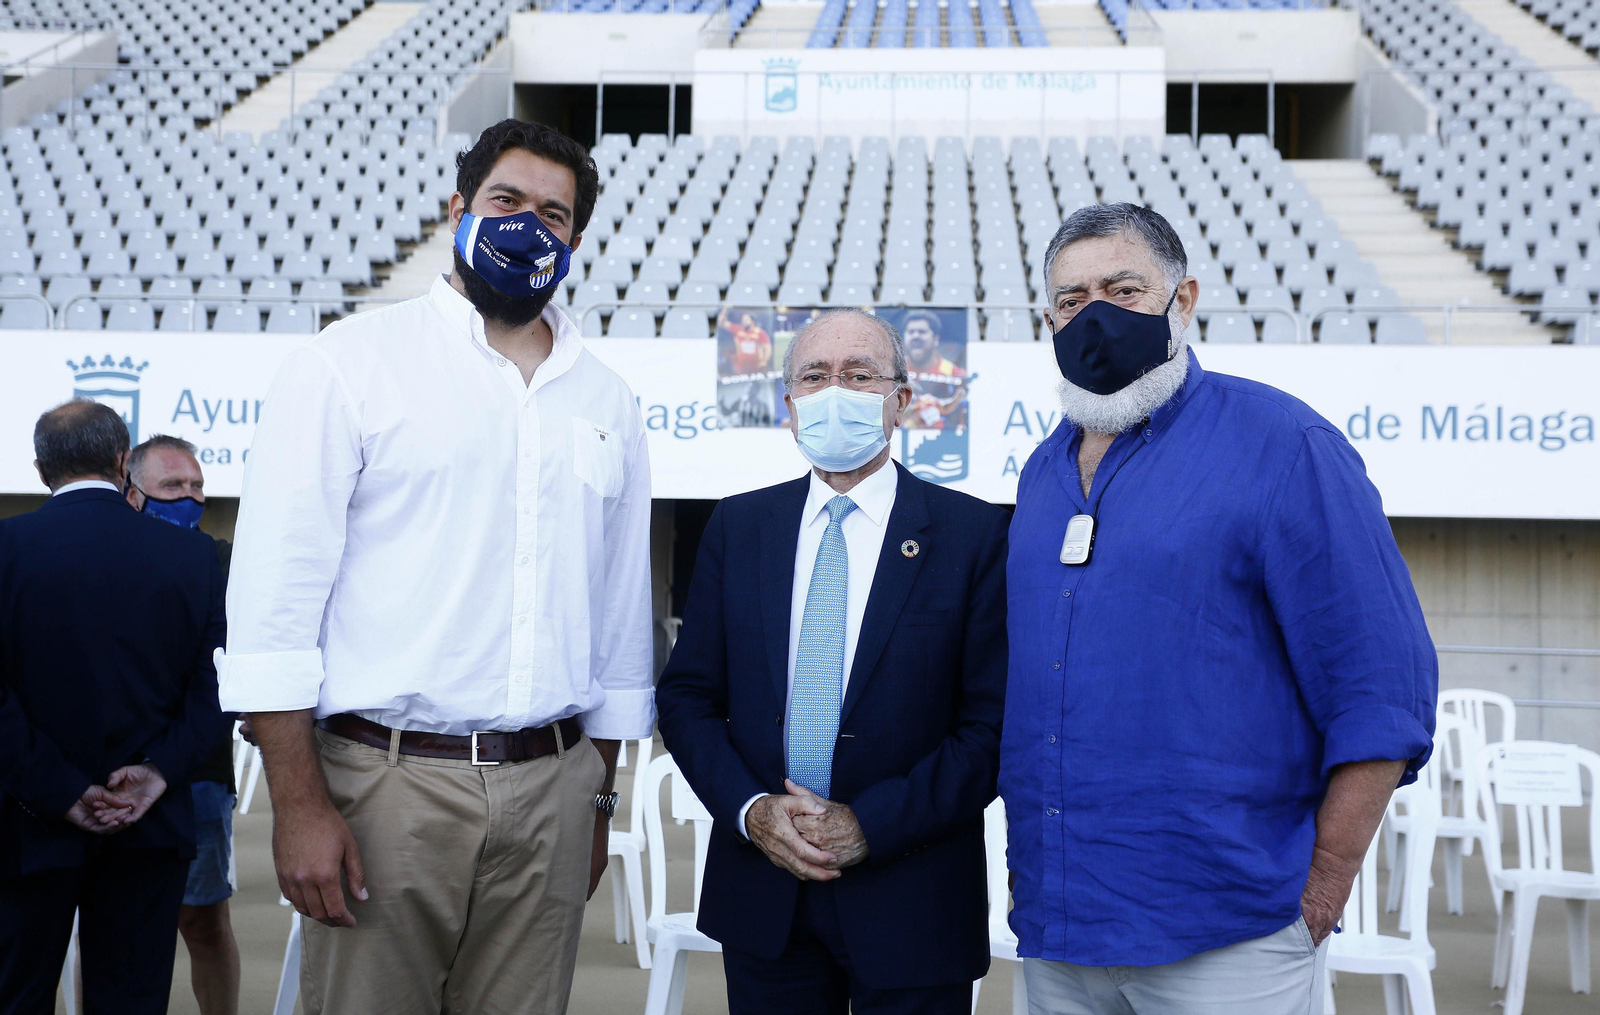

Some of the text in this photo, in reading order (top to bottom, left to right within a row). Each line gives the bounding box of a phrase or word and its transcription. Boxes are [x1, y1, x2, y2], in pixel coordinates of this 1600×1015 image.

[818, 71, 973, 95] Ayuntamiento
[981, 72, 1007, 90] de
[1347, 402, 1595, 451] de Málaga
